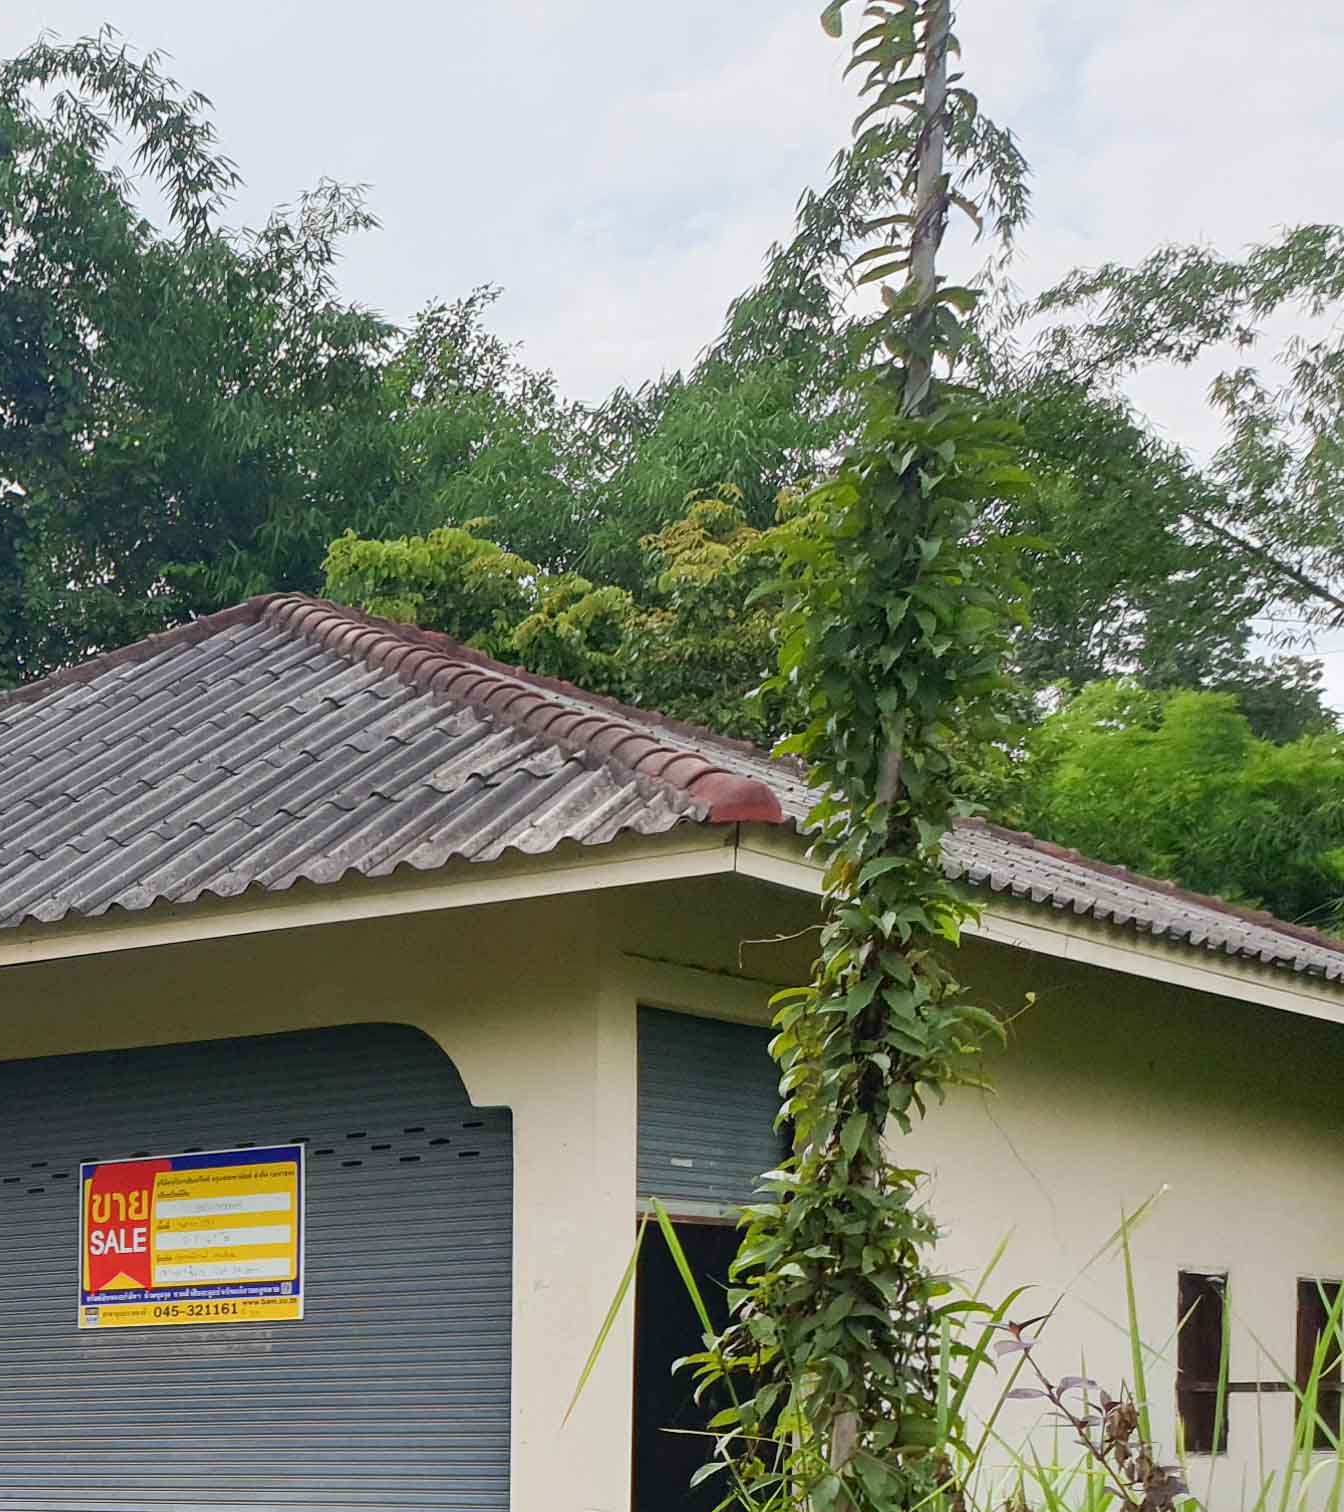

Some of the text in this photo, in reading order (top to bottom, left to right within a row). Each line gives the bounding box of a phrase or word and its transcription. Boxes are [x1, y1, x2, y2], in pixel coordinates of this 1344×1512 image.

[92, 1189, 148, 1223] ขาย
[90, 1227, 147, 1255] SALE
[153, 1303, 238, 1318] 045-321161
